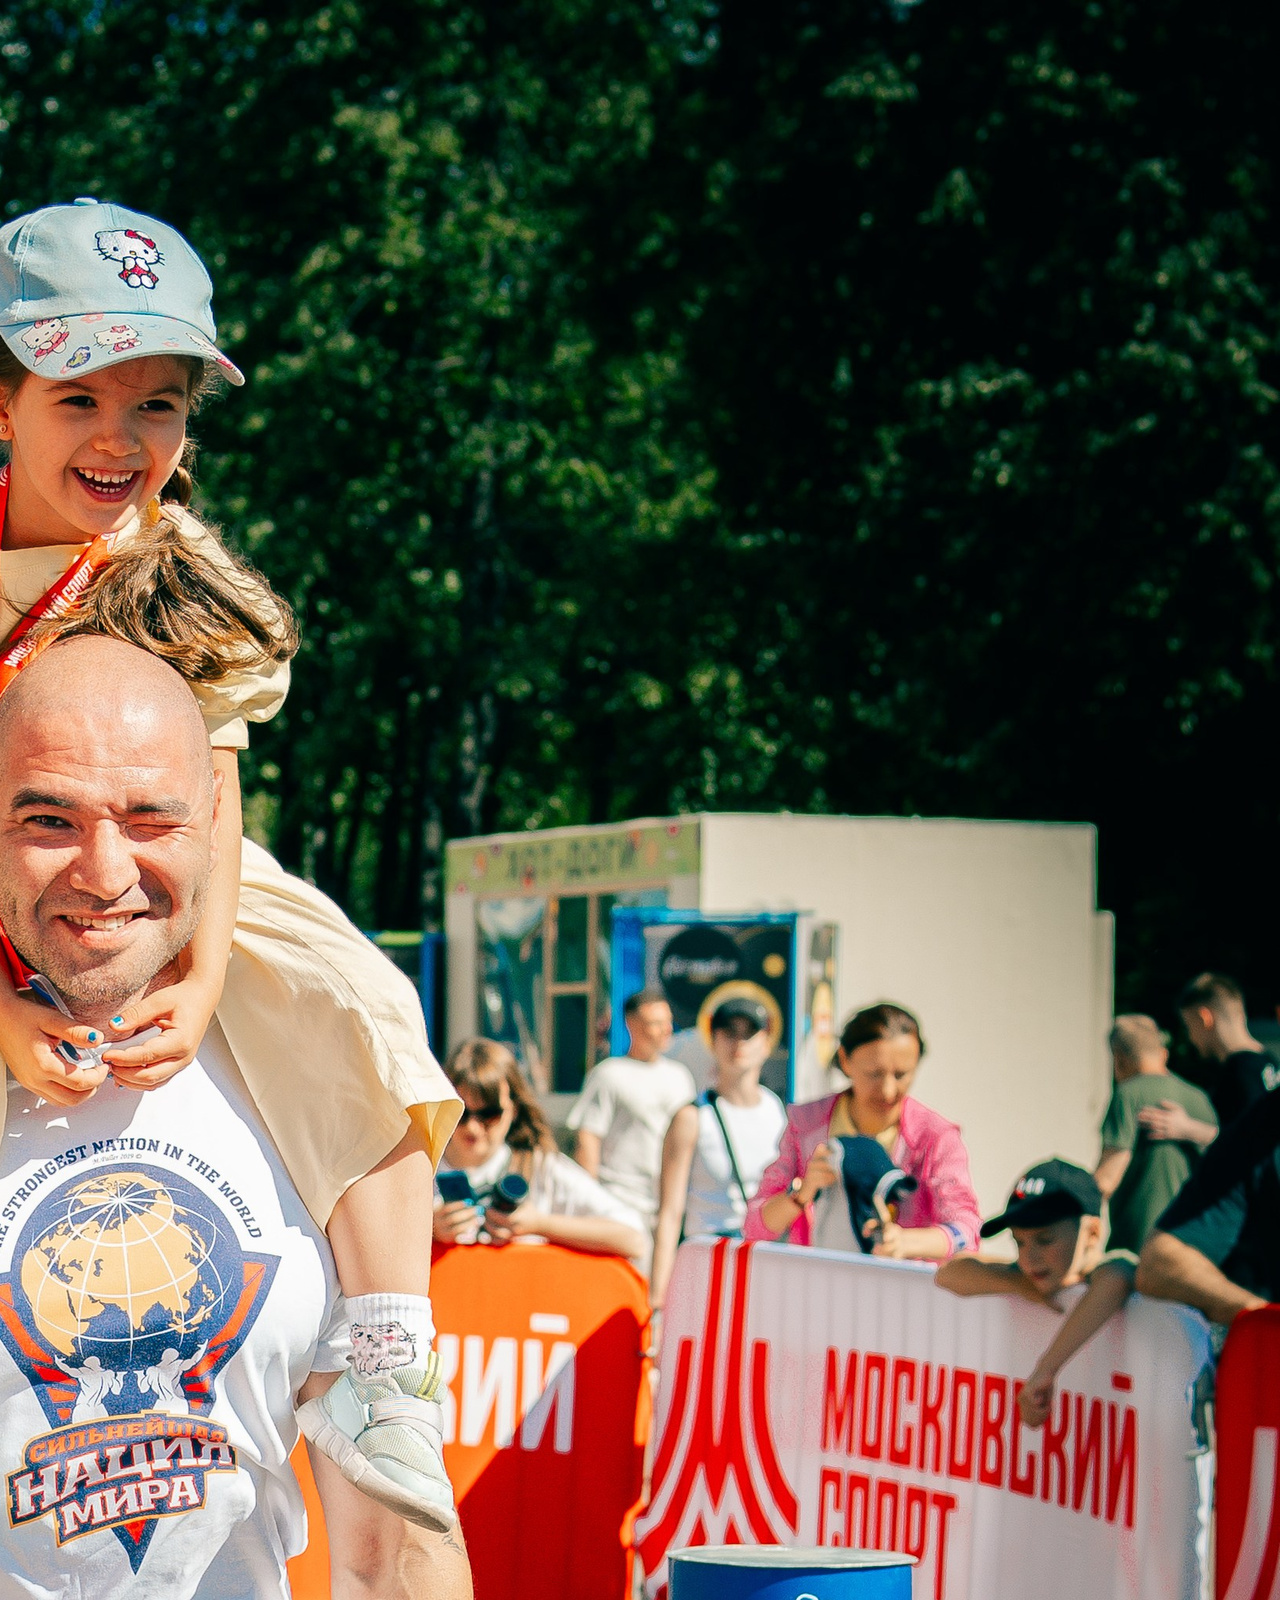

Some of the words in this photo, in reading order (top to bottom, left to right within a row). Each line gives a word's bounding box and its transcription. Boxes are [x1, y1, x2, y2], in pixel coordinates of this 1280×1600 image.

[2, 1145, 88, 1222] STRONGEST
[91, 1136, 161, 1155] NATION
[163, 1143, 184, 1161] IN
[186, 1153, 221, 1184] THE
[217, 1180, 262, 1239] WORLD
[29, 1417, 227, 1463] СИЛЬНЕЙШАЯ
[13, 1436, 233, 1519] НАЦИЯ
[60, 1474, 201, 1537] МИРА
